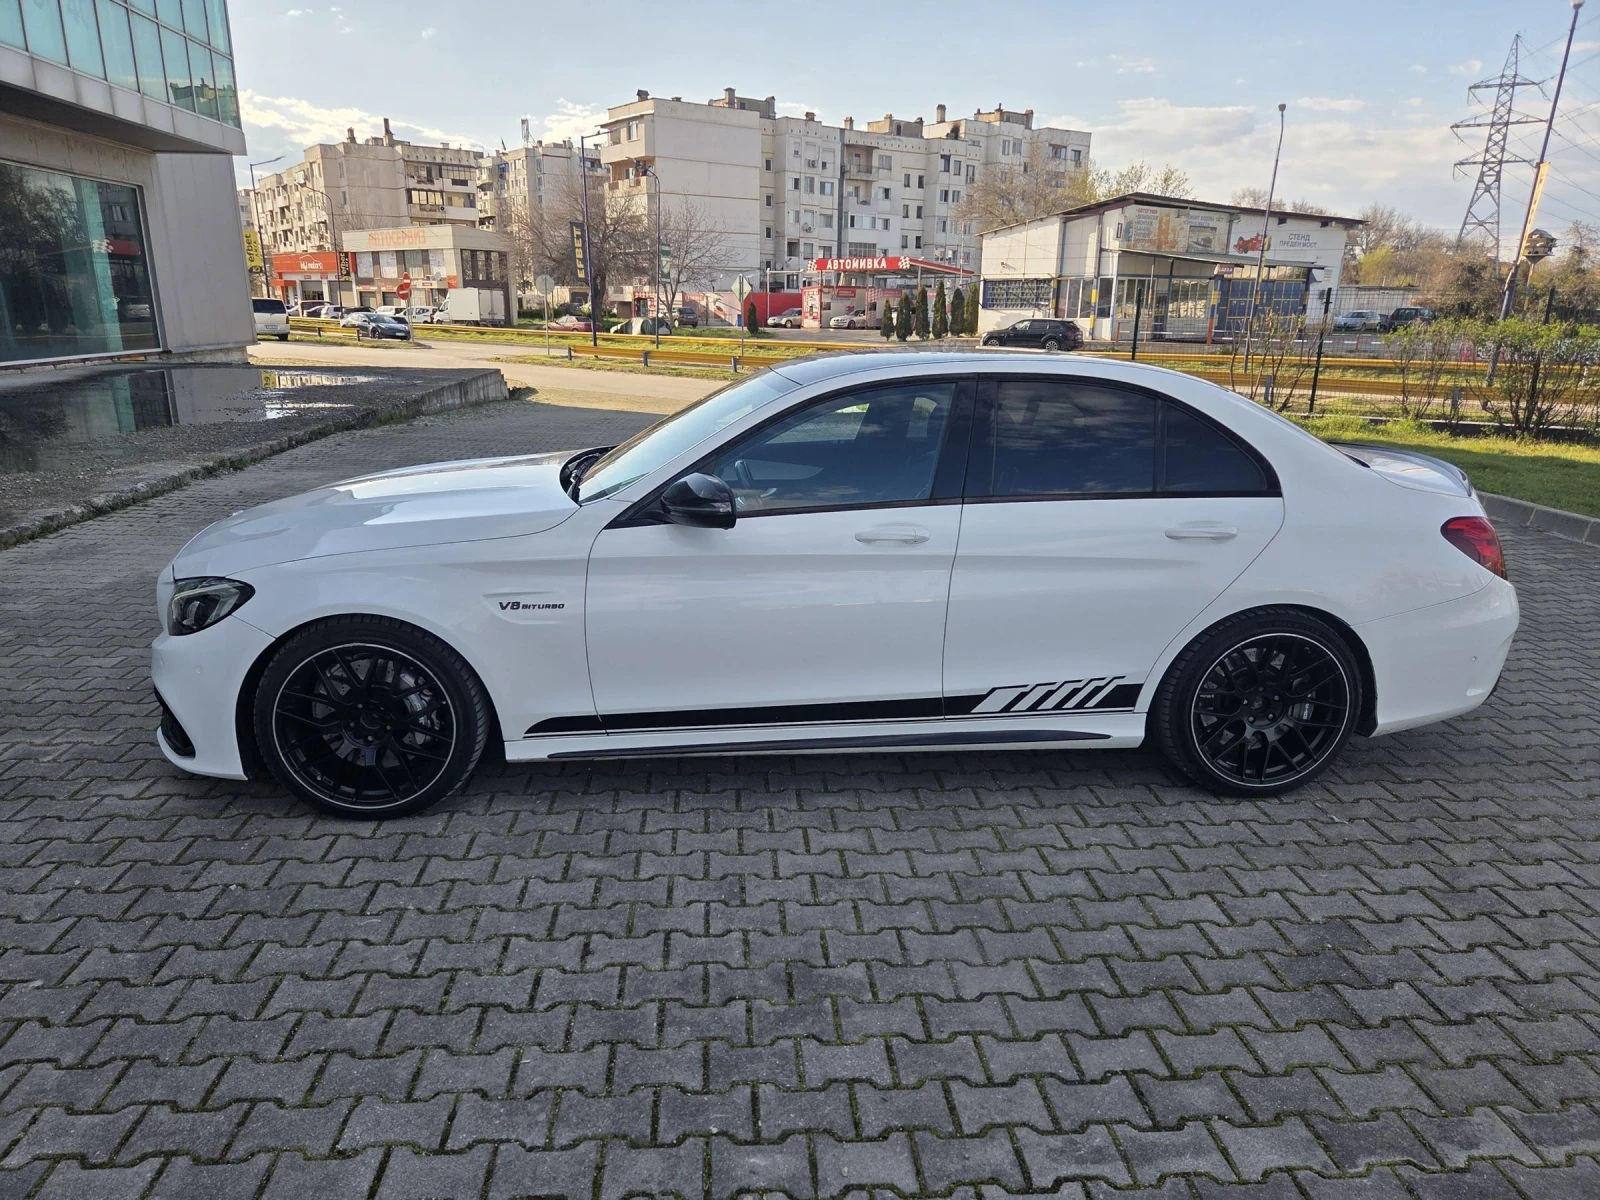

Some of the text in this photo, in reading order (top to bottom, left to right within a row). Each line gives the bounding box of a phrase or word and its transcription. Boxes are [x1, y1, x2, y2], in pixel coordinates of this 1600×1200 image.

[1289, 233, 1310, 241] СТЕНД
[573, 226, 585, 278] EFBET
[826, 257, 887, 270] АВТОМИВКА
[499, 601, 521, 610] V8
